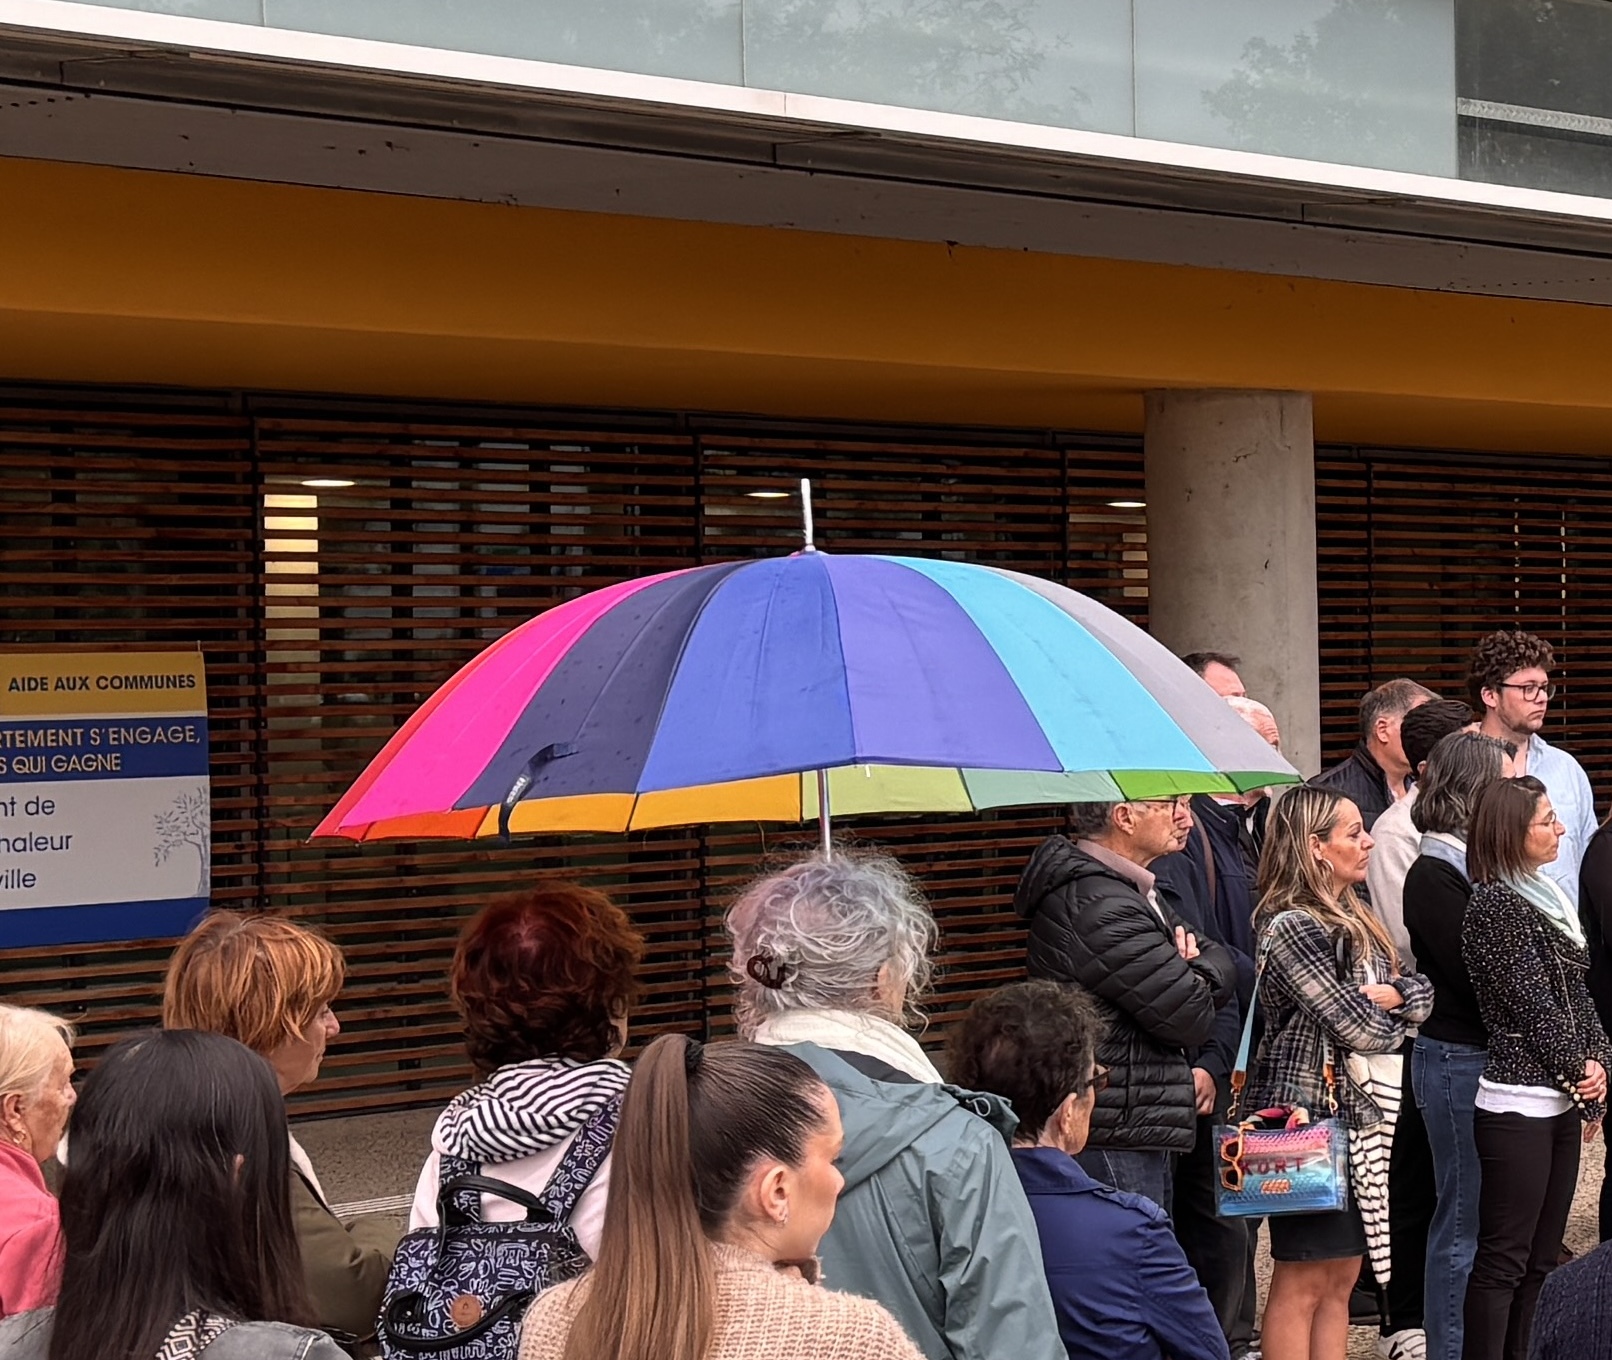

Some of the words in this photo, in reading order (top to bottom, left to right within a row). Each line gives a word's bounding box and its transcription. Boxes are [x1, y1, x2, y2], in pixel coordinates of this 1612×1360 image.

[8, 676, 48, 692] AIDE
[54, 675, 90, 692] AUX
[96, 674, 196, 690] COMMUNES
[90, 725, 201, 746] S'ENGAGE,
[12, 755, 46, 774] QUI
[51, 753, 121, 772] GAGNE
[24, 795, 55, 816] de
